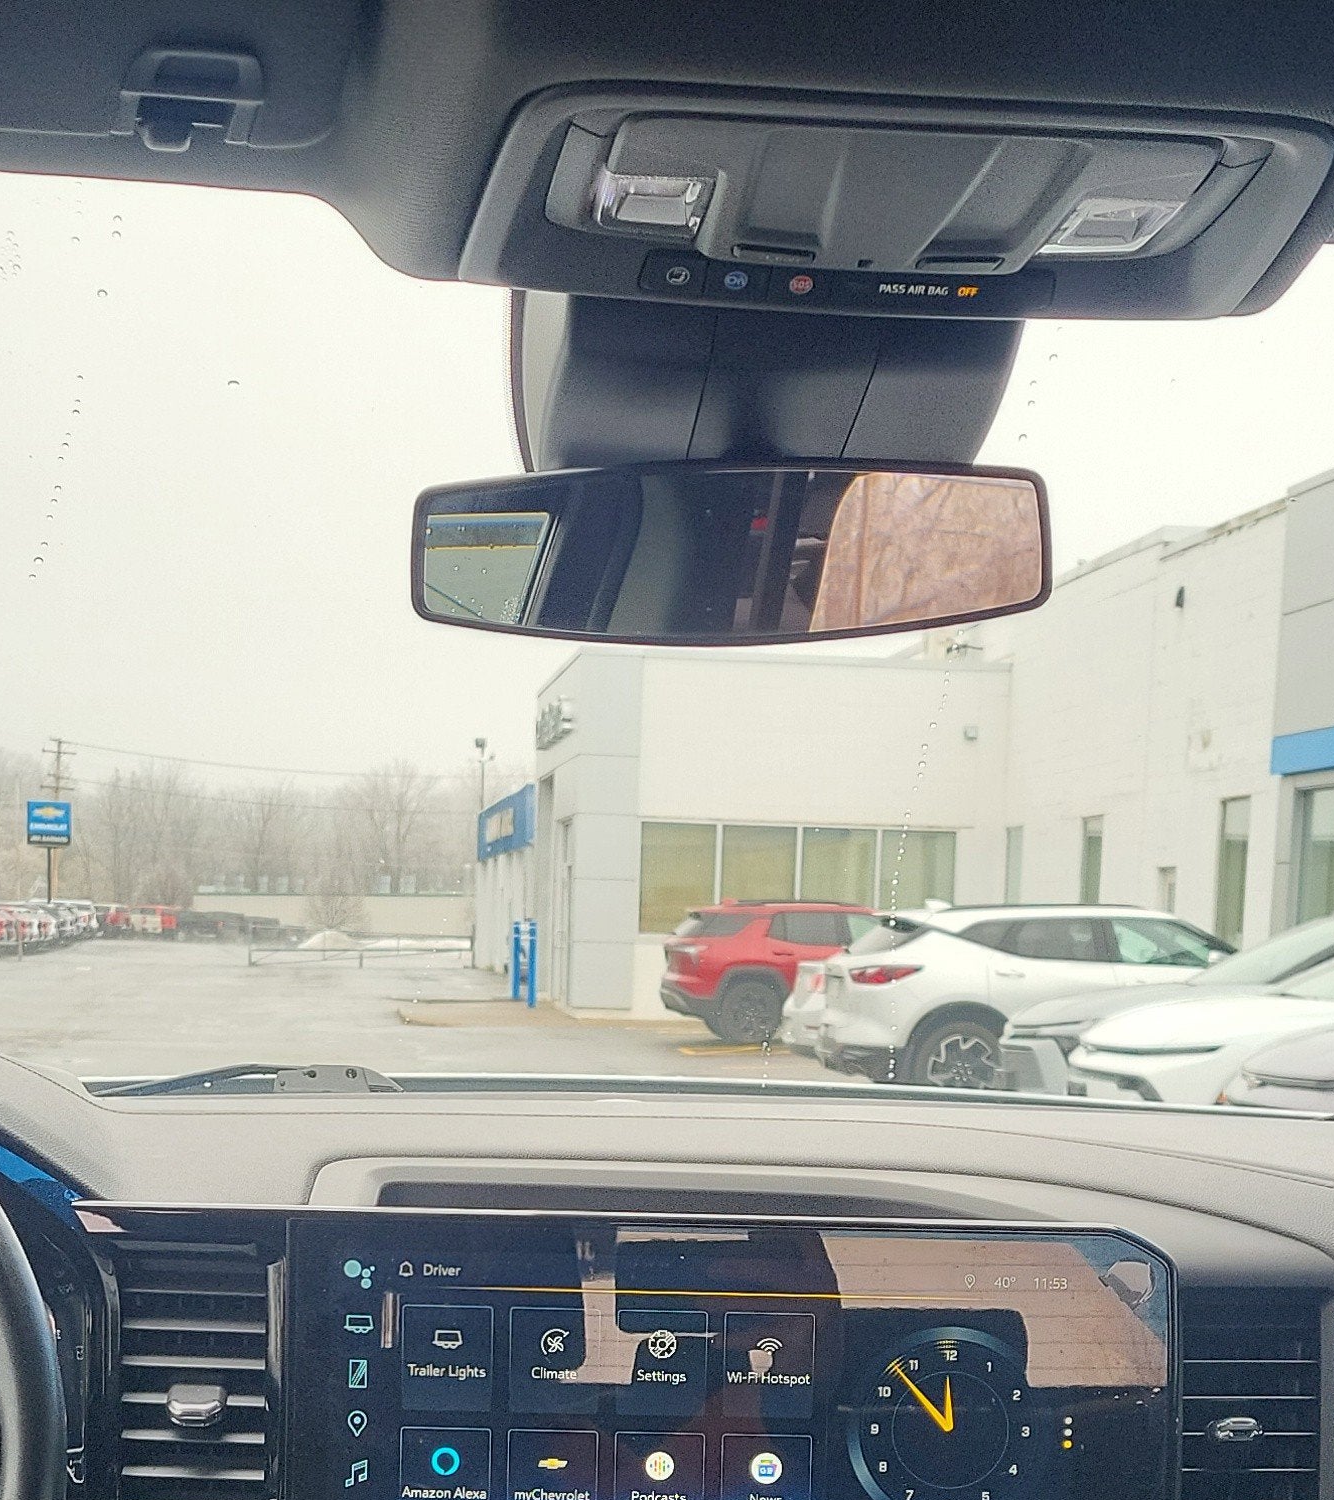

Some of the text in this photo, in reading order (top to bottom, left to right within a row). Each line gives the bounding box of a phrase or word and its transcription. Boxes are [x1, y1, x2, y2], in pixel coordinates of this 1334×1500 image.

[879, 284, 979, 297] PASS AIR BAG OFF
[423, 1264, 461, 1278] Driver
[994, 1275, 1068, 1290] 40° 11:53
[944, 1350, 958, 1361] 12
[908, 1360, 919, 1371] 11
[987, 1362, 993, 1372] 1
[407, 1364, 487, 1380] Trailer Lights
[531, 1367, 577, 1380] Climate
[637, 1370, 687, 1385] Settings
[726, 1372, 811, 1387] Wi-Fi Hotspot
[877, 1386, 891, 1398] 10
[1012, 1390, 1021, 1401] 2
[870, 1424, 879, 1435] 9
[1021, 1426, 1030, 1437] 3
[879, 1462, 888, 1473] 8
[1009, 1464, 1018, 1475] 4
[402, 1486, 487, 1500] Amazon Alexa
[905, 1490, 914, 1500] 7
